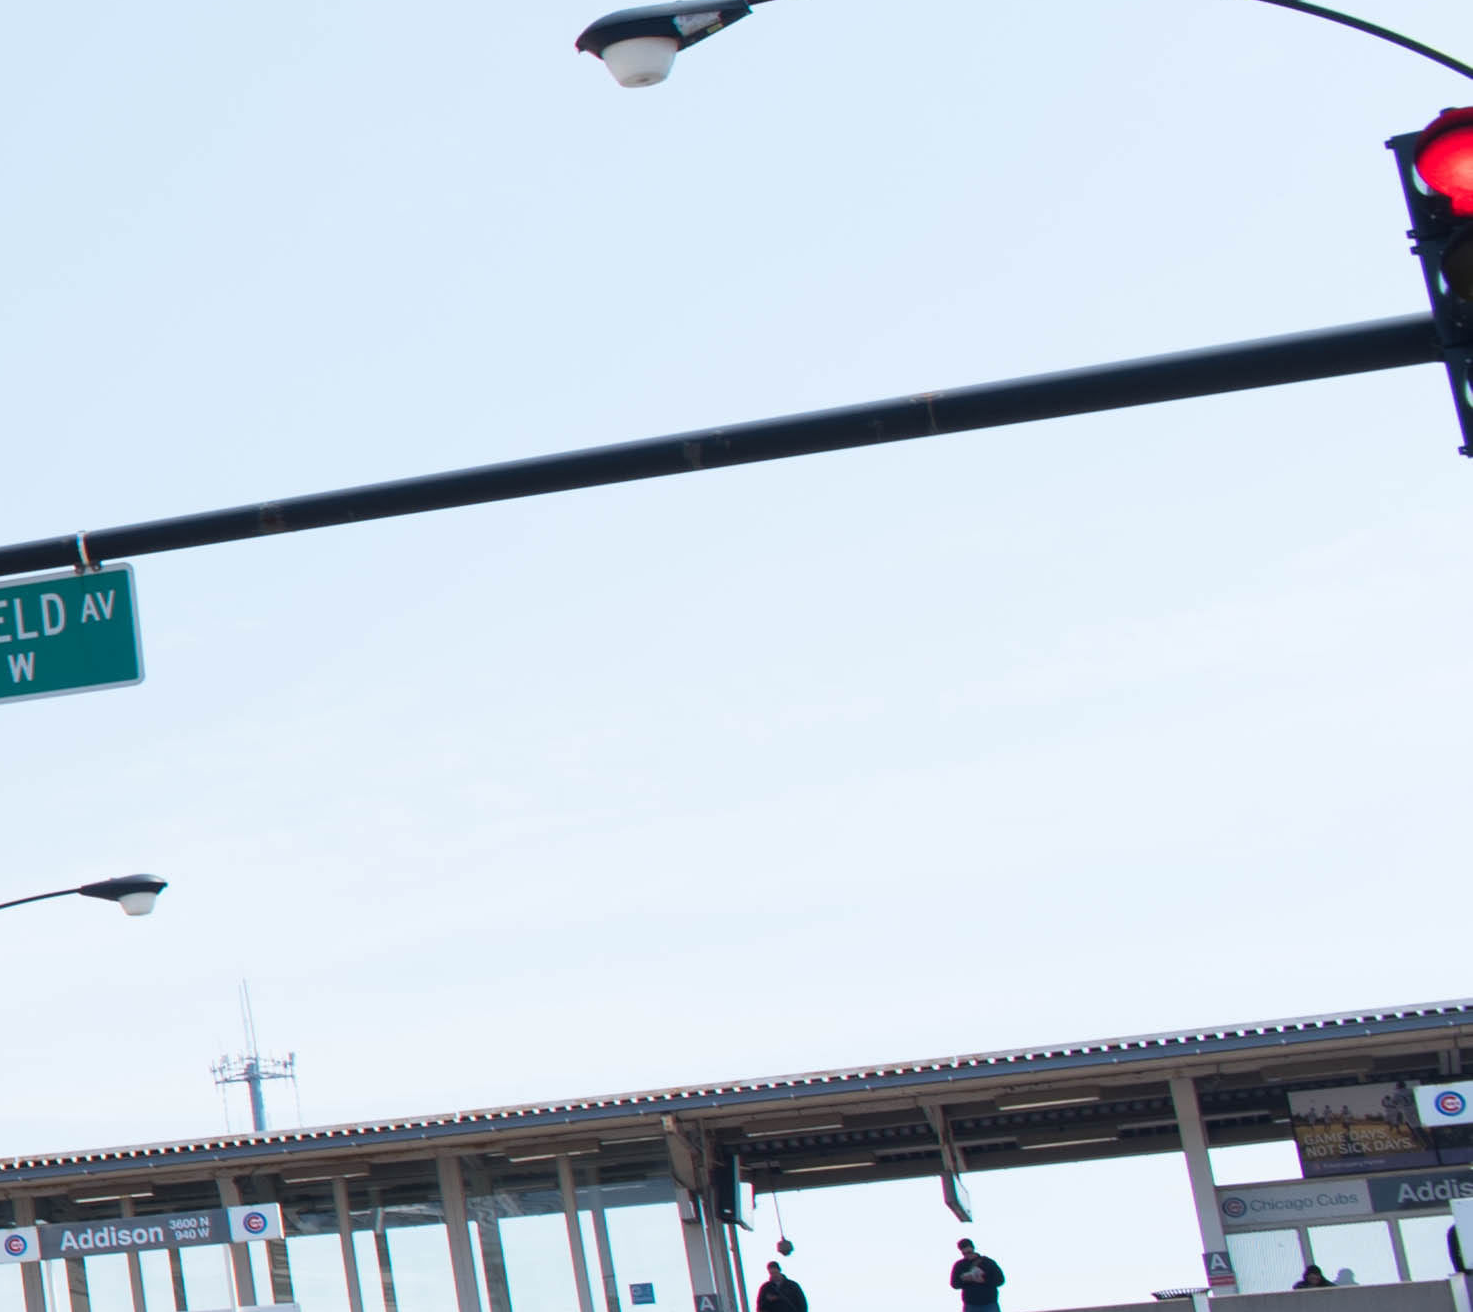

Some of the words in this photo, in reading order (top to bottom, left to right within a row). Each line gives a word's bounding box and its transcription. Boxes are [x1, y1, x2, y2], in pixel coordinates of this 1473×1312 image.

[81, 589, 116, 624] AV
[7, 652, 36, 684] W
[1304, 1131, 1346, 1146] GAME
[1306, 1144, 1336, 1158] NOT
[1339, 1142, 1371, 1155] SICK
[1250, 1197, 1313, 1212] Chicago
[1316, 1193, 1358, 1206] Cubs
[60, 1225, 165, 1252] Addison
[168, 1218, 197, 1231] 3600
[199, 1217, 210, 1227] N
[174, 1228, 197, 1241] 940
[197, 1227, 210, 1239] W
[1211, 1253, 1229, 1269] A
[700, 1296, 715, 1311] A
